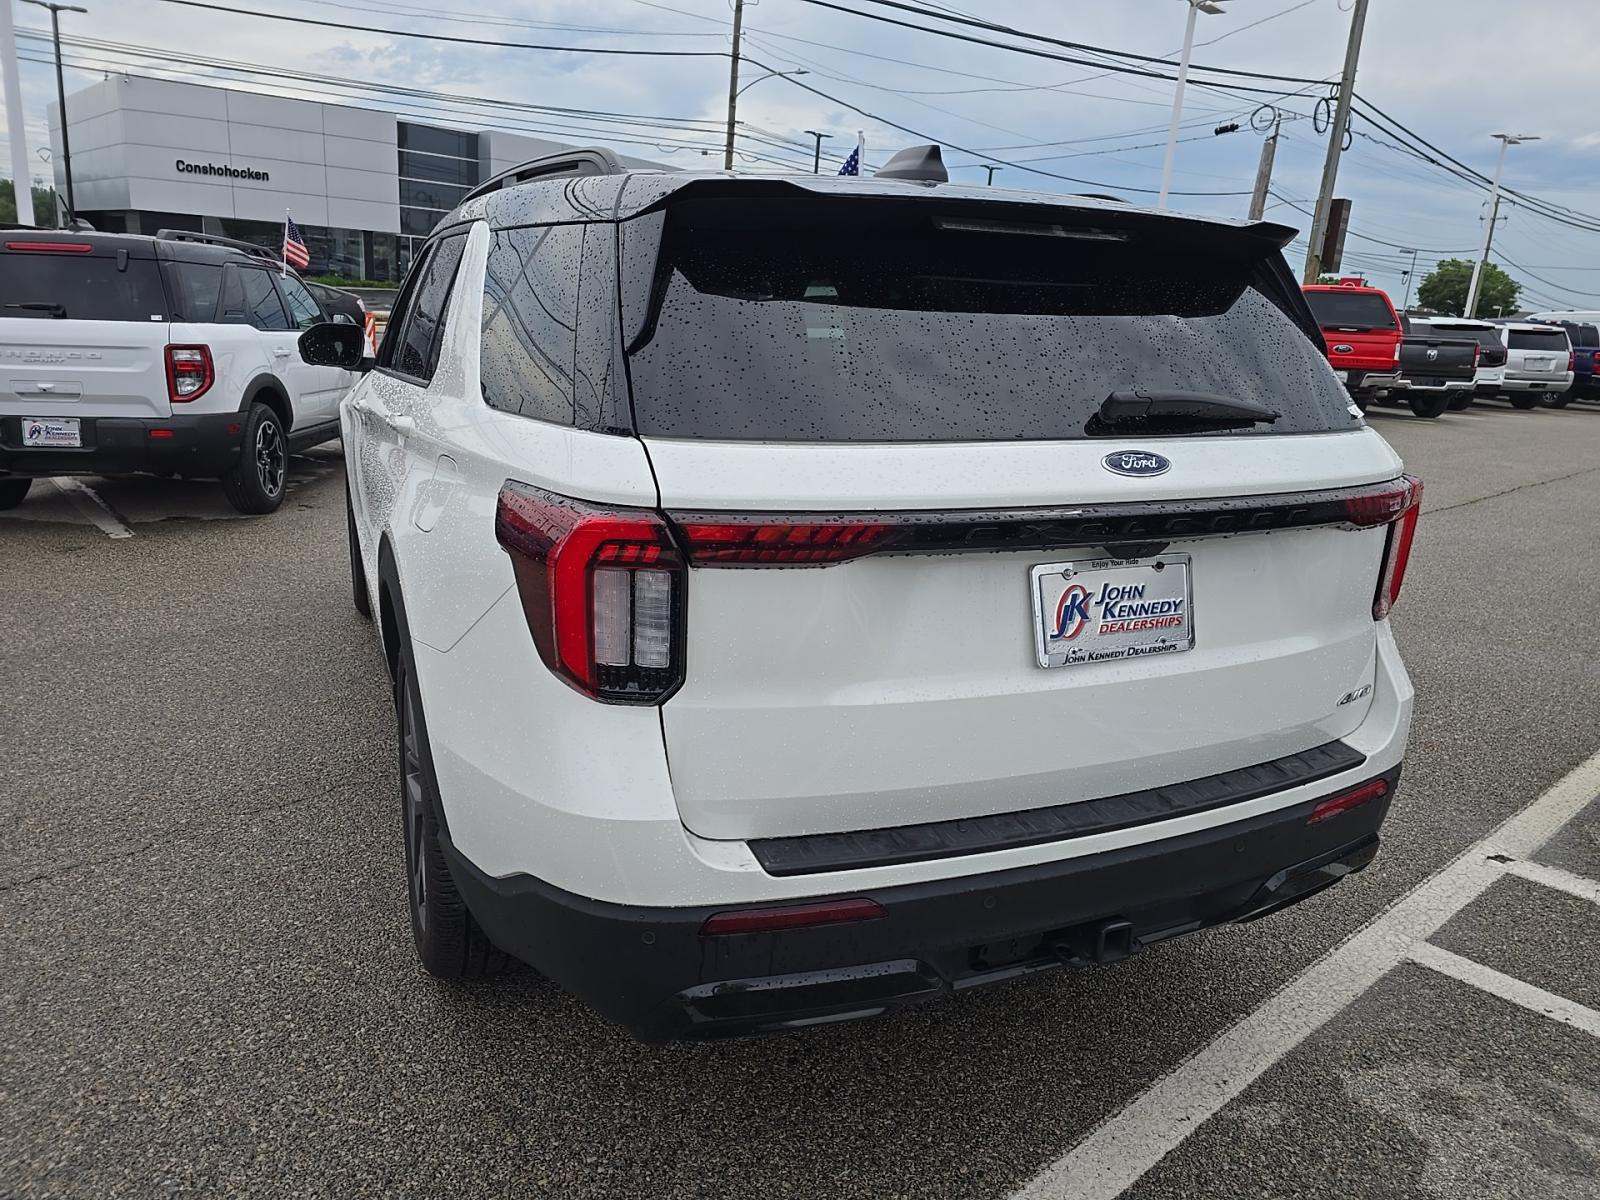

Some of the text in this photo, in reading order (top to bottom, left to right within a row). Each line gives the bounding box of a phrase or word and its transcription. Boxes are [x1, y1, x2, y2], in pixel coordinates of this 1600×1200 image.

[175, 159, 270, 181] Conshohocken
[0, 350, 102, 360] RONCO
[1121, 453, 1159, 469] Ford
[1091, 561, 1109, 569] Enjoy
[1095, 583, 1145, 605] JOHN
[1102, 599, 1184, 620] KENNEDY
[1099, 616, 1183, 634] DEALERSHIPS
[1062, 643, 1178, 665] JOHN KENNEDY DEALERSHIPS
